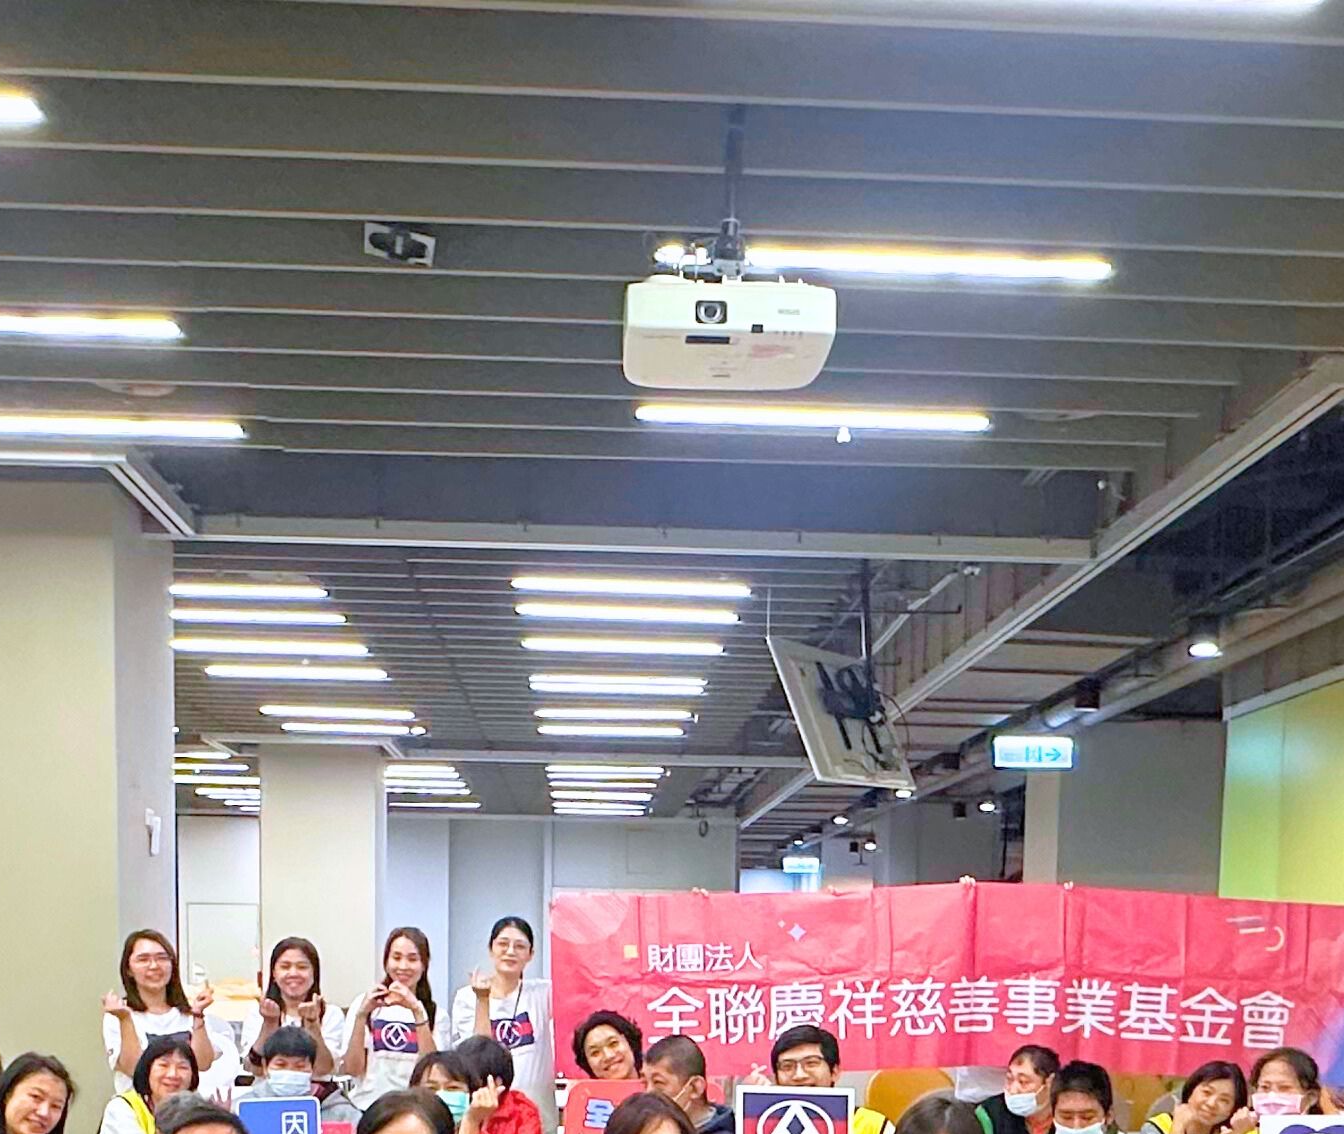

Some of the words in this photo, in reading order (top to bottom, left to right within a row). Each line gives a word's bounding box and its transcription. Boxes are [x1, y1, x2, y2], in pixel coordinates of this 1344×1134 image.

[647, 941, 764, 973] 財團法人
[647, 976, 1295, 1049] 全聯慶祥慈善事業基金會
